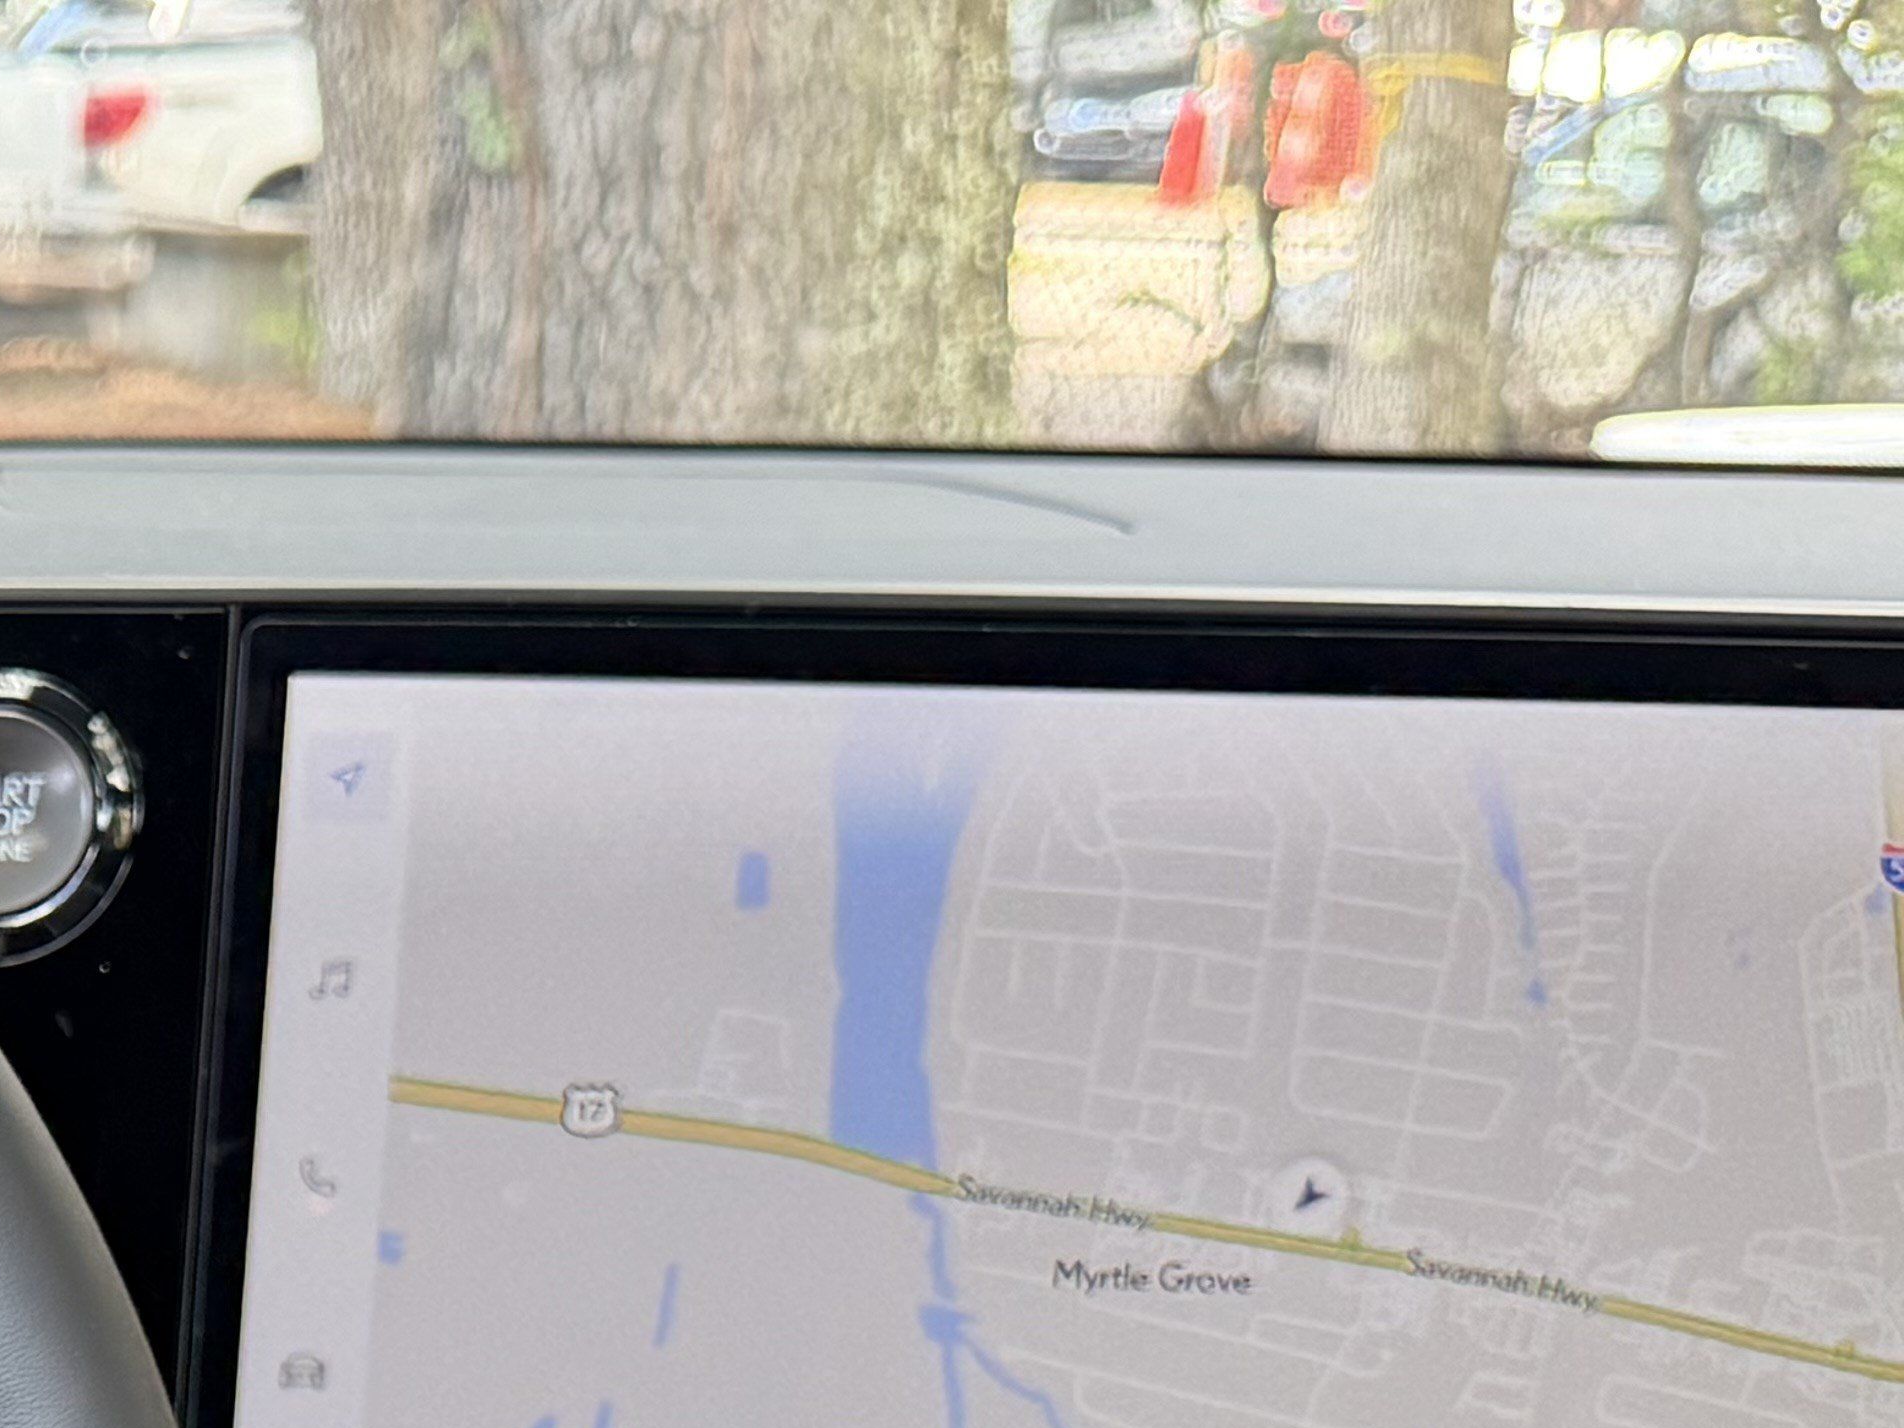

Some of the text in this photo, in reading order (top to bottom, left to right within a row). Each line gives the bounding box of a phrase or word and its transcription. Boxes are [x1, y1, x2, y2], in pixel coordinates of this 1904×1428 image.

[578, 1101, 604, 1121] 17
[957, 1173, 1081, 1217] Savannah
[1052, 1260, 1252, 1296] Myrtle Grove
[1407, 1247, 1531, 1294] Savannah
